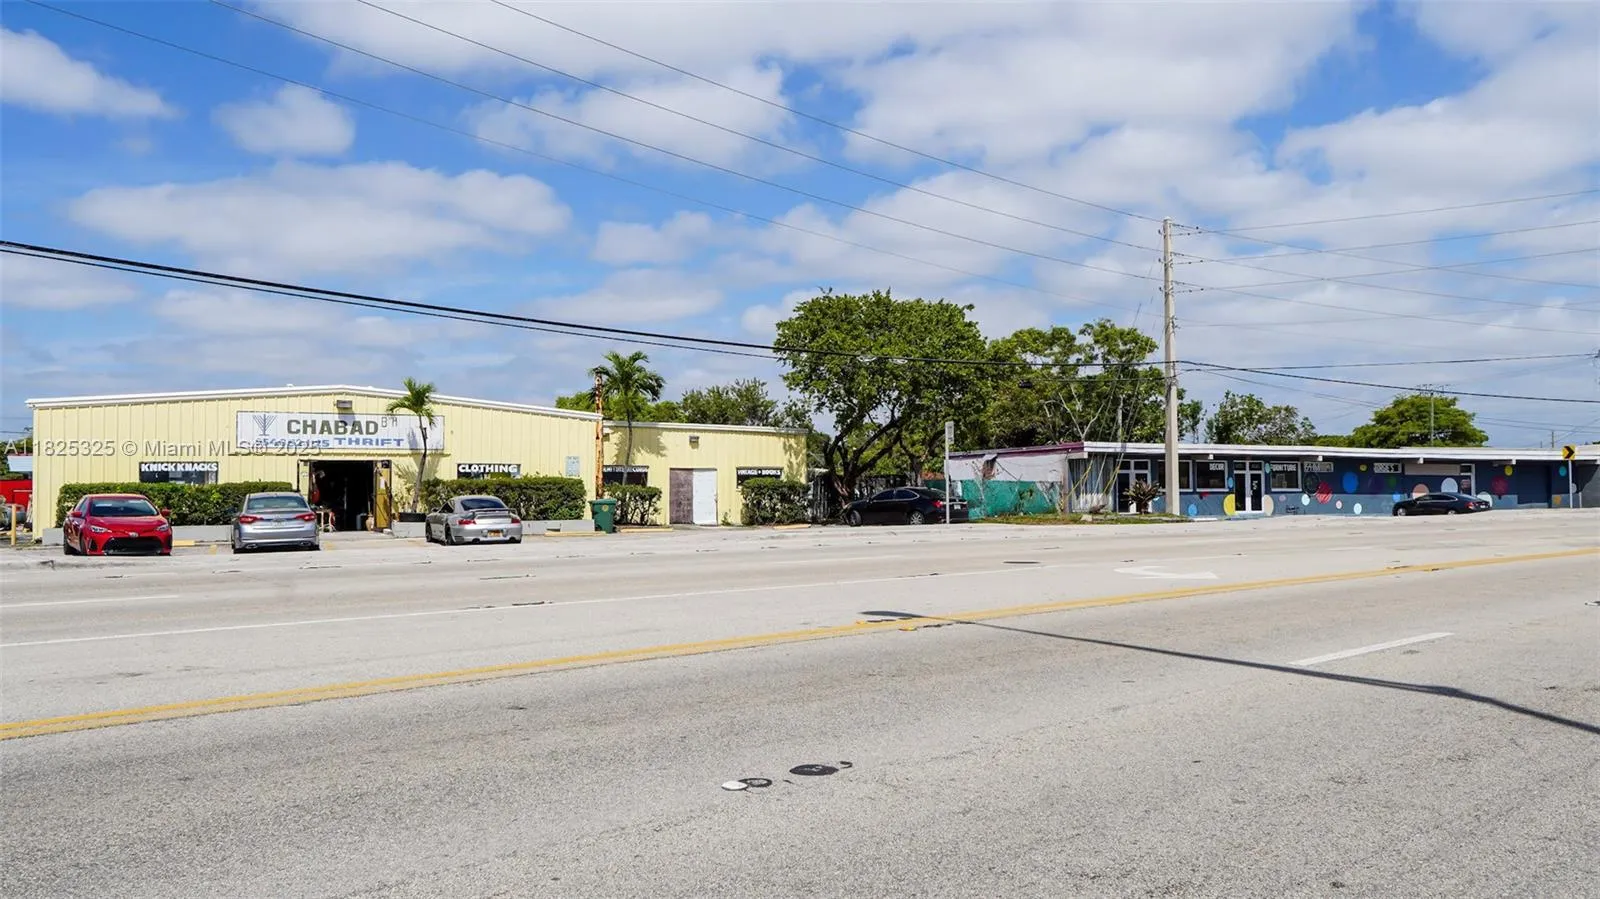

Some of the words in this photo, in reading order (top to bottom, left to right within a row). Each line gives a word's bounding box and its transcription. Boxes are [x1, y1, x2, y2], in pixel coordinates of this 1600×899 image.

[286, 419, 379, 435] CHABAD
[334, 437, 405, 448] THRIFT
[140, 463, 176, 472] KNICK
[176, 463, 218, 472] KNACKS
[458, 464, 518, 473] CLOTHING
